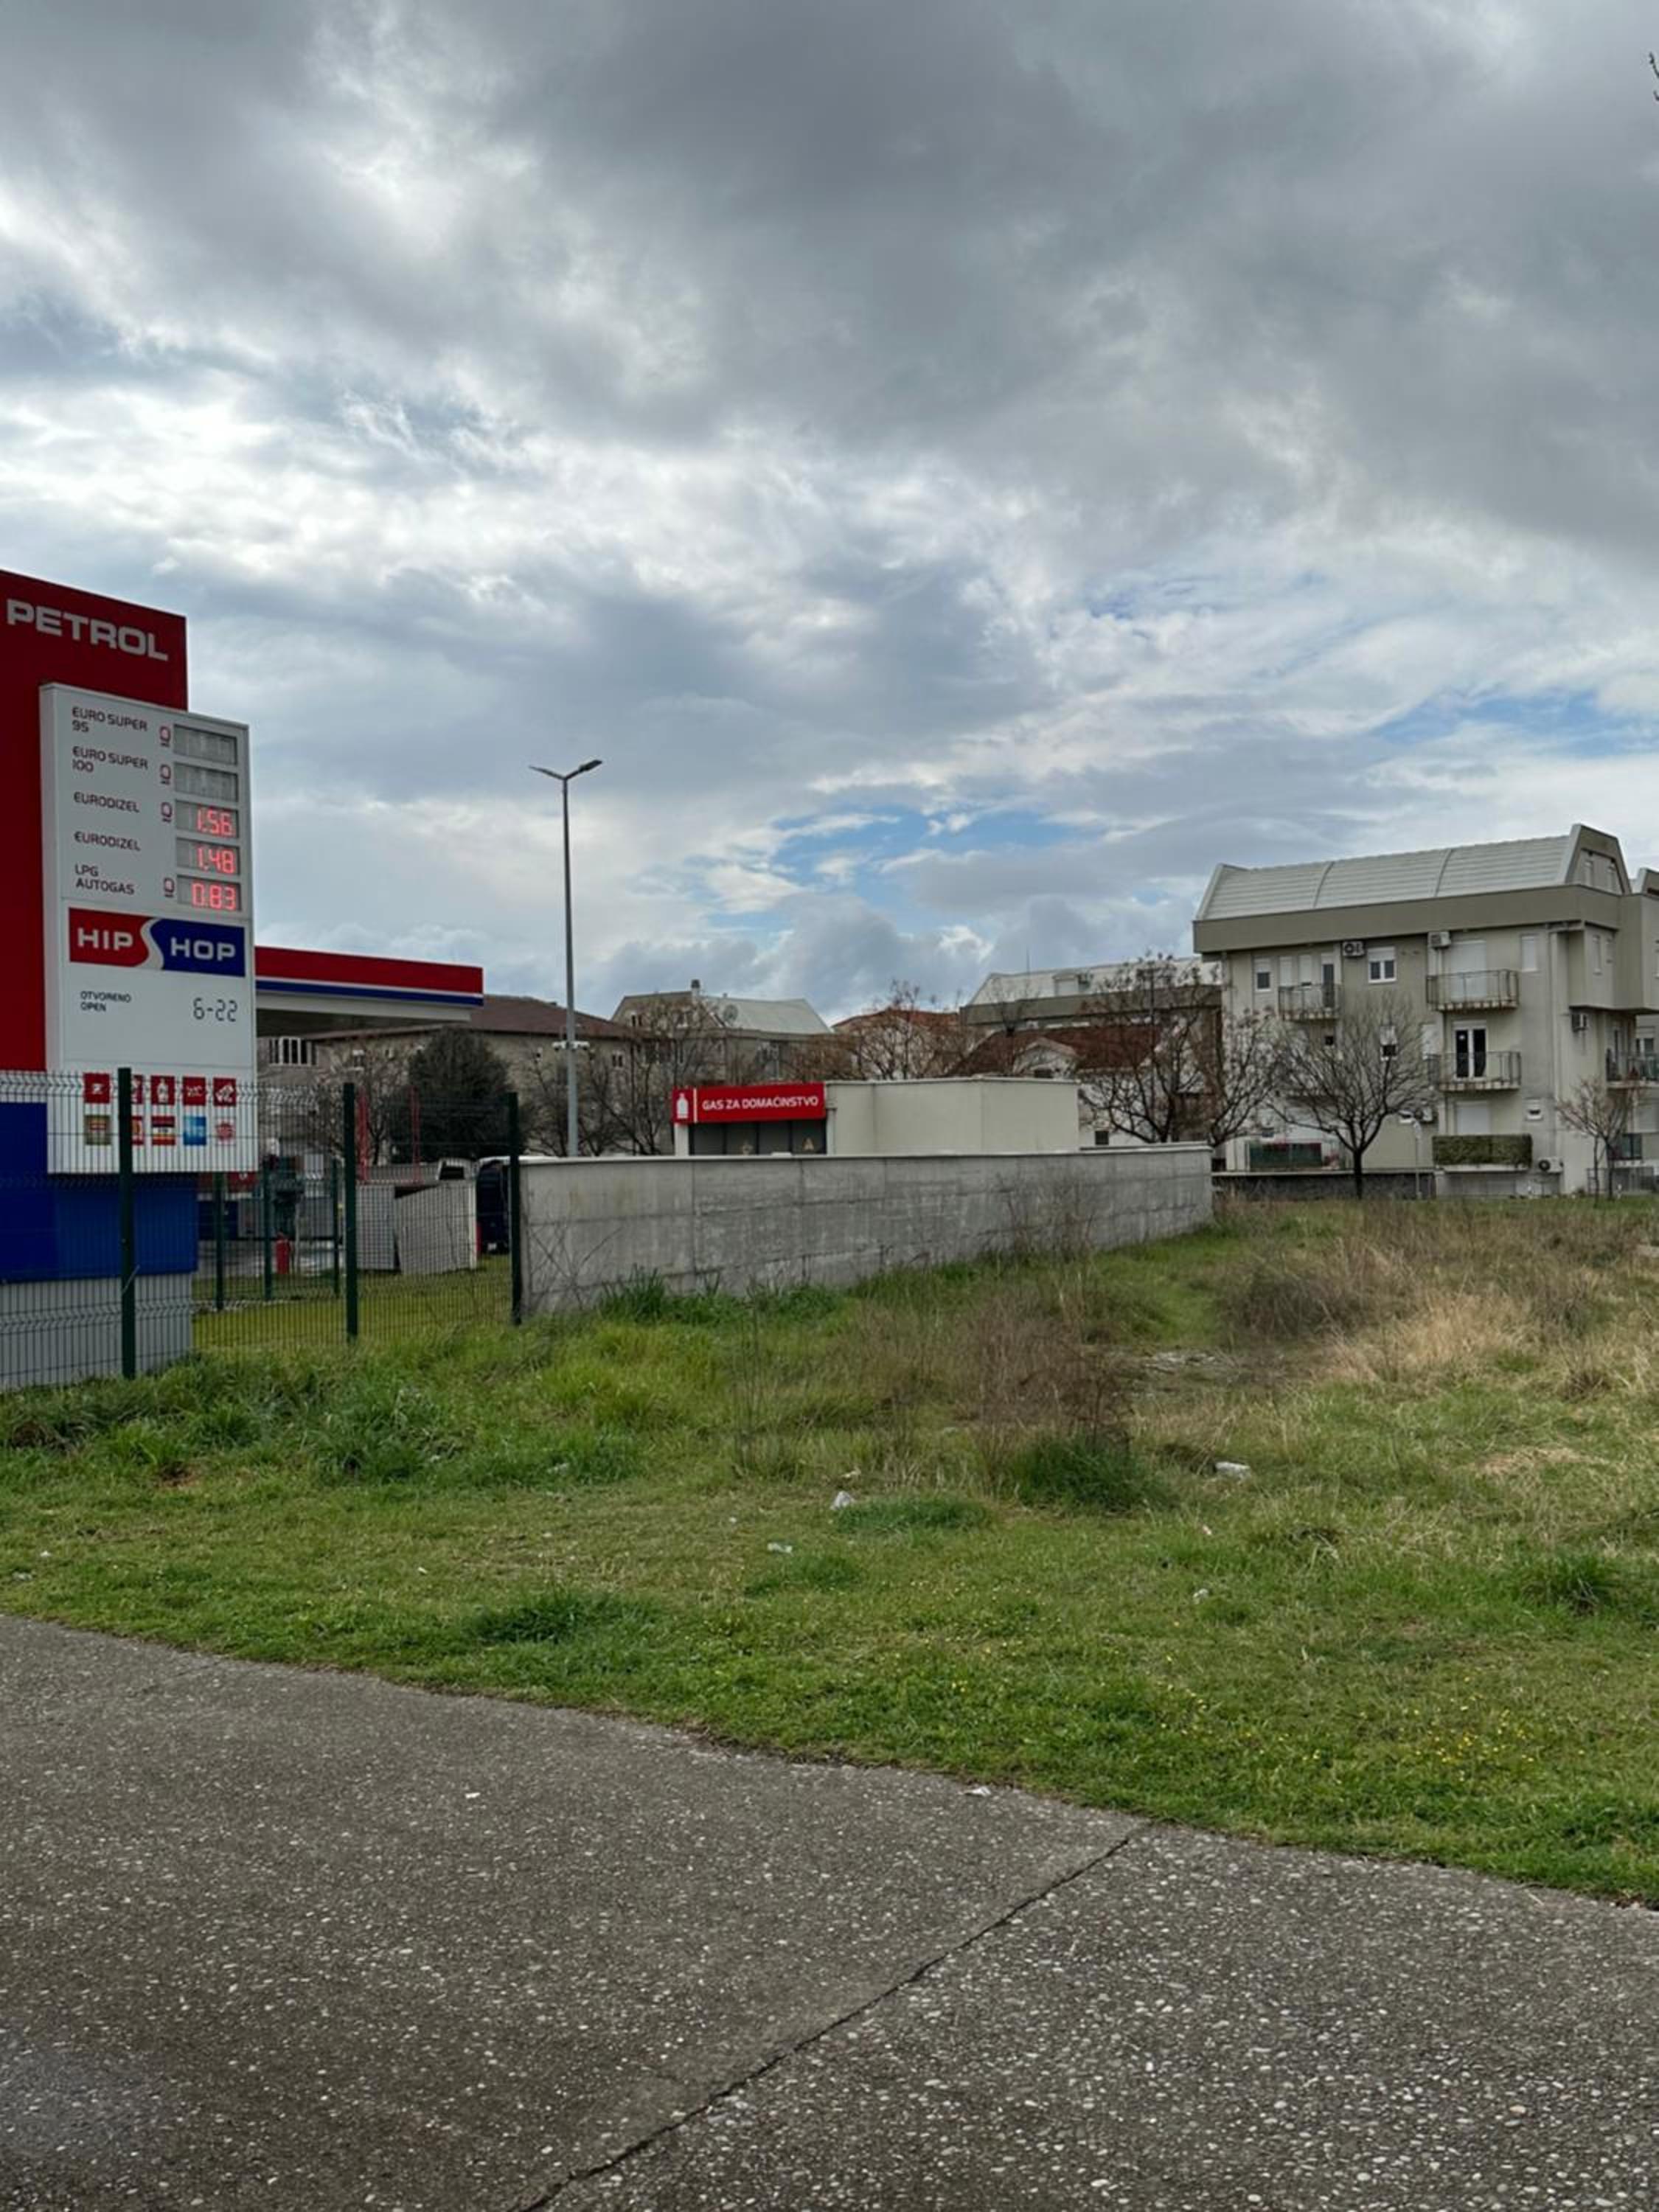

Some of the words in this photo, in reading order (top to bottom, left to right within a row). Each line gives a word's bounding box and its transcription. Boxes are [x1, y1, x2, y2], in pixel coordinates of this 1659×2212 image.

[7, 599, 168, 661] PETROL
[72, 706, 105, 723] EURO
[107, 714, 147, 732] SUPER
[72, 720, 89, 733] 95
[72, 745, 106, 762] EURO
[108, 753, 148, 771] SUPER
[74, 790, 140, 813] EURODIZEL
[197, 807, 234, 837] 1.56
[74, 830, 141, 852] EURODIZEL
[75, 864, 99, 877] LPG
[198, 846, 235, 875] 1.48
[76, 878, 135, 896] AUTOGAS
[192, 882, 237, 911] 0.83
[77, 927, 133, 950] HIP
[170, 936, 236, 961] HOP
[80, 991, 131, 1004] OTVORENO
[80, 1001, 107, 1012] OPEN
[702, 1099, 724, 1110] GAS
[726, 1099, 740, 1110] ZA
